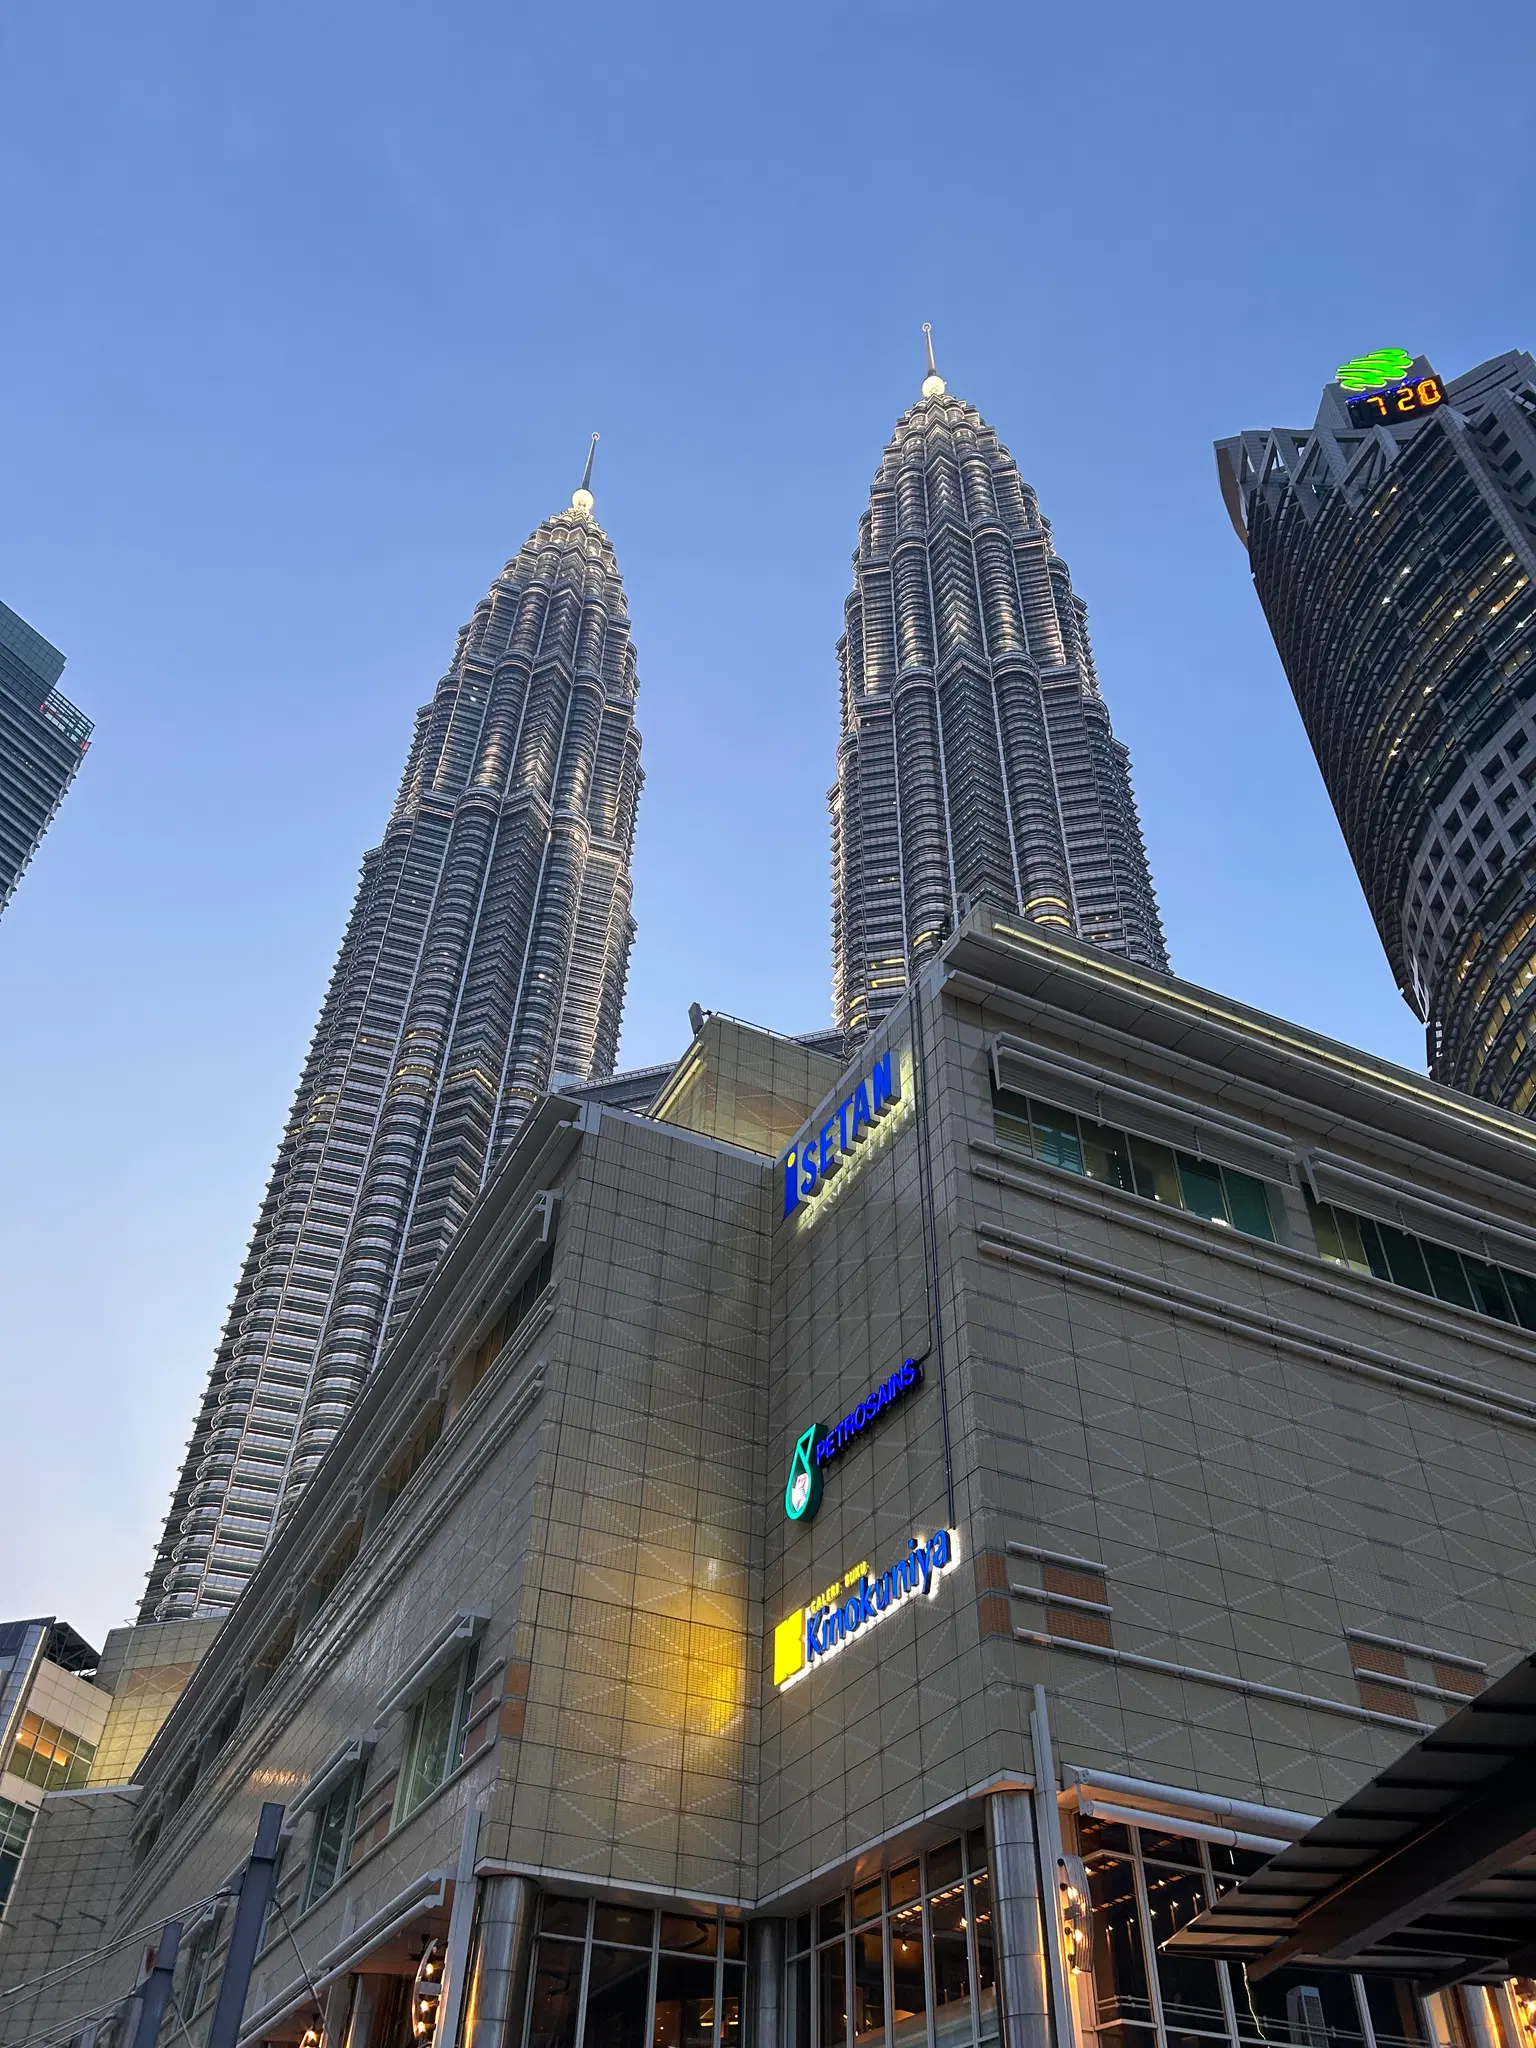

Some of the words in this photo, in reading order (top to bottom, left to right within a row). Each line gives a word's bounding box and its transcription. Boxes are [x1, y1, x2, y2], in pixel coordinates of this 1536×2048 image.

[816, 1357, 917, 1466] PETROSAINS
[806, 1529, 951, 1662] Kinokuniya
[810, 1582, 842, 1614] GALERI
[844, 1560, 869, 1588] BUKU
